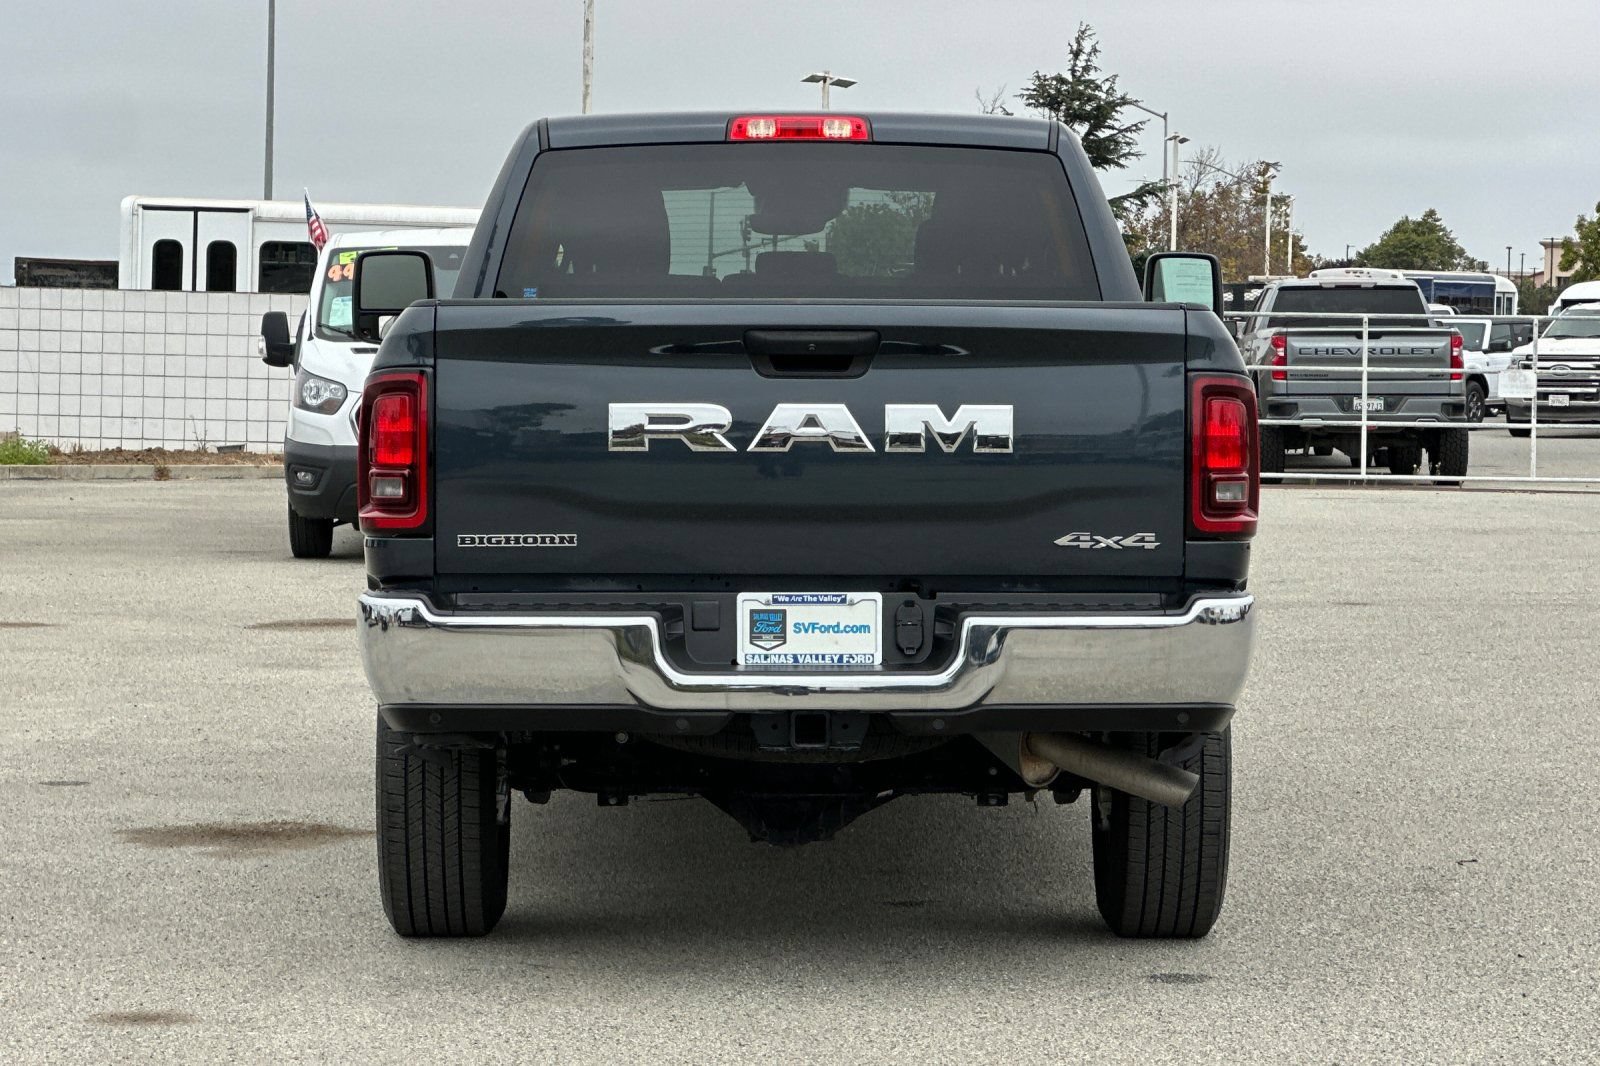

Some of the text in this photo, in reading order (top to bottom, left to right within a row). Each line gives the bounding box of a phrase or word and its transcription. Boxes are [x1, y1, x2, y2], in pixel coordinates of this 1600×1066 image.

[1298, 347, 1439, 356] CHEVROLET
[608, 402, 1014, 454] RAM
[457, 534, 577, 547] BIGHORN
[753, 621, 782, 633] Ford
[793, 622, 871, 634] SVFord.com
[797, 654, 839, 664] VALLEY
[843, 654, 874, 664] FORD
